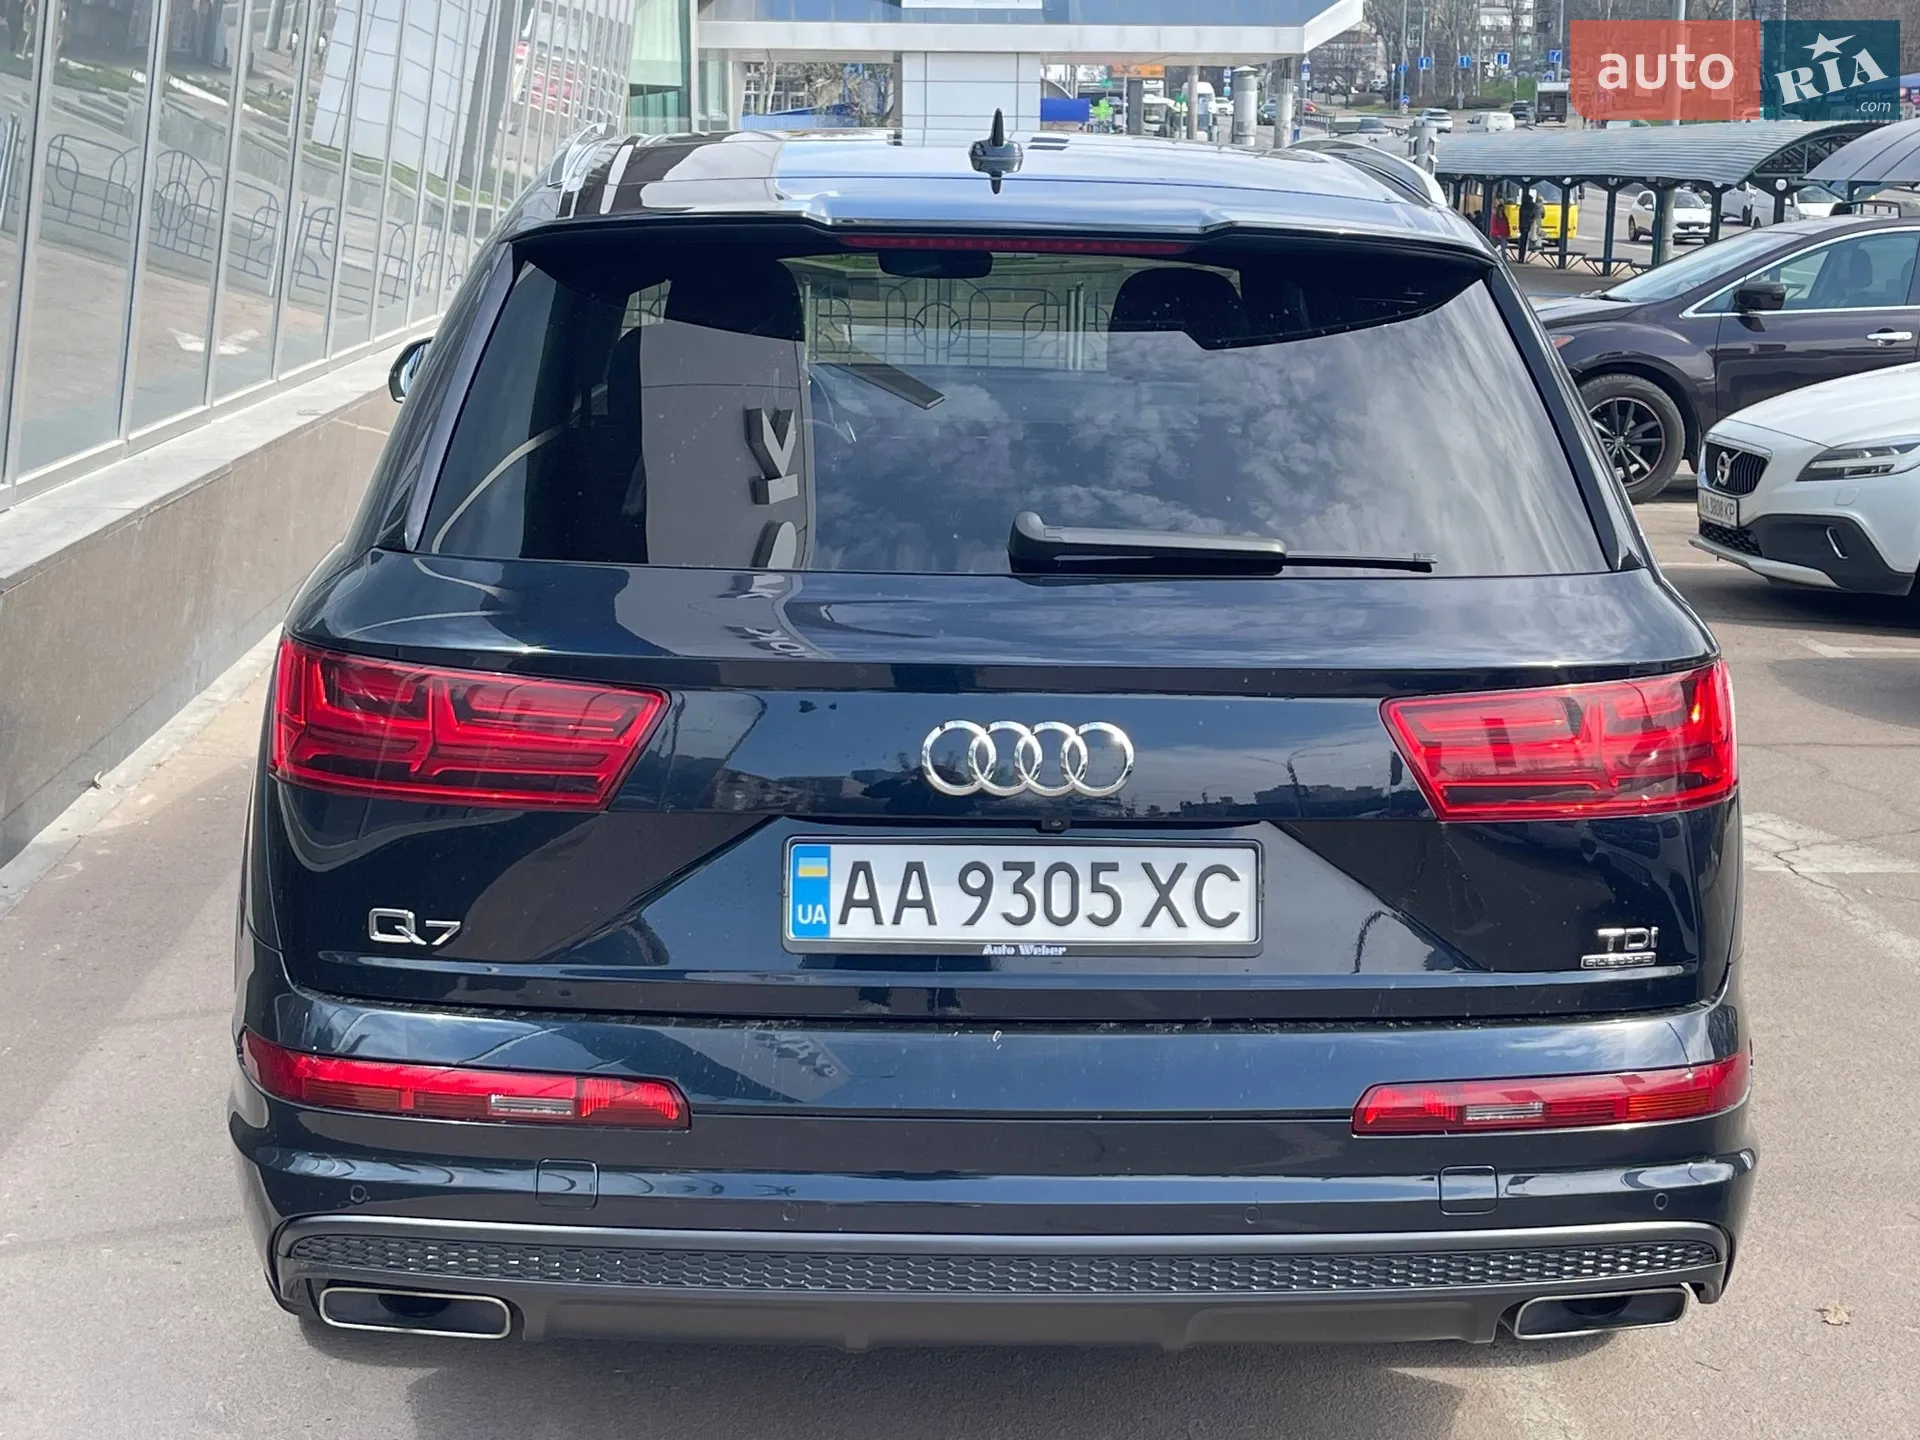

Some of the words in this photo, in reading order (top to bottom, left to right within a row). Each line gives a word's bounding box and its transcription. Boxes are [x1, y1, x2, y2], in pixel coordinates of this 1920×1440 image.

[838, 860, 938, 927] AA
[958, 860, 1123, 927] 9305
[1140, 862, 1242, 928] XC
[368, 907, 462, 946] Q7
[798, 904, 828, 925] UA
[981, 943, 1016, 956] Auto
[1018, 943, 1068, 956] Weber
